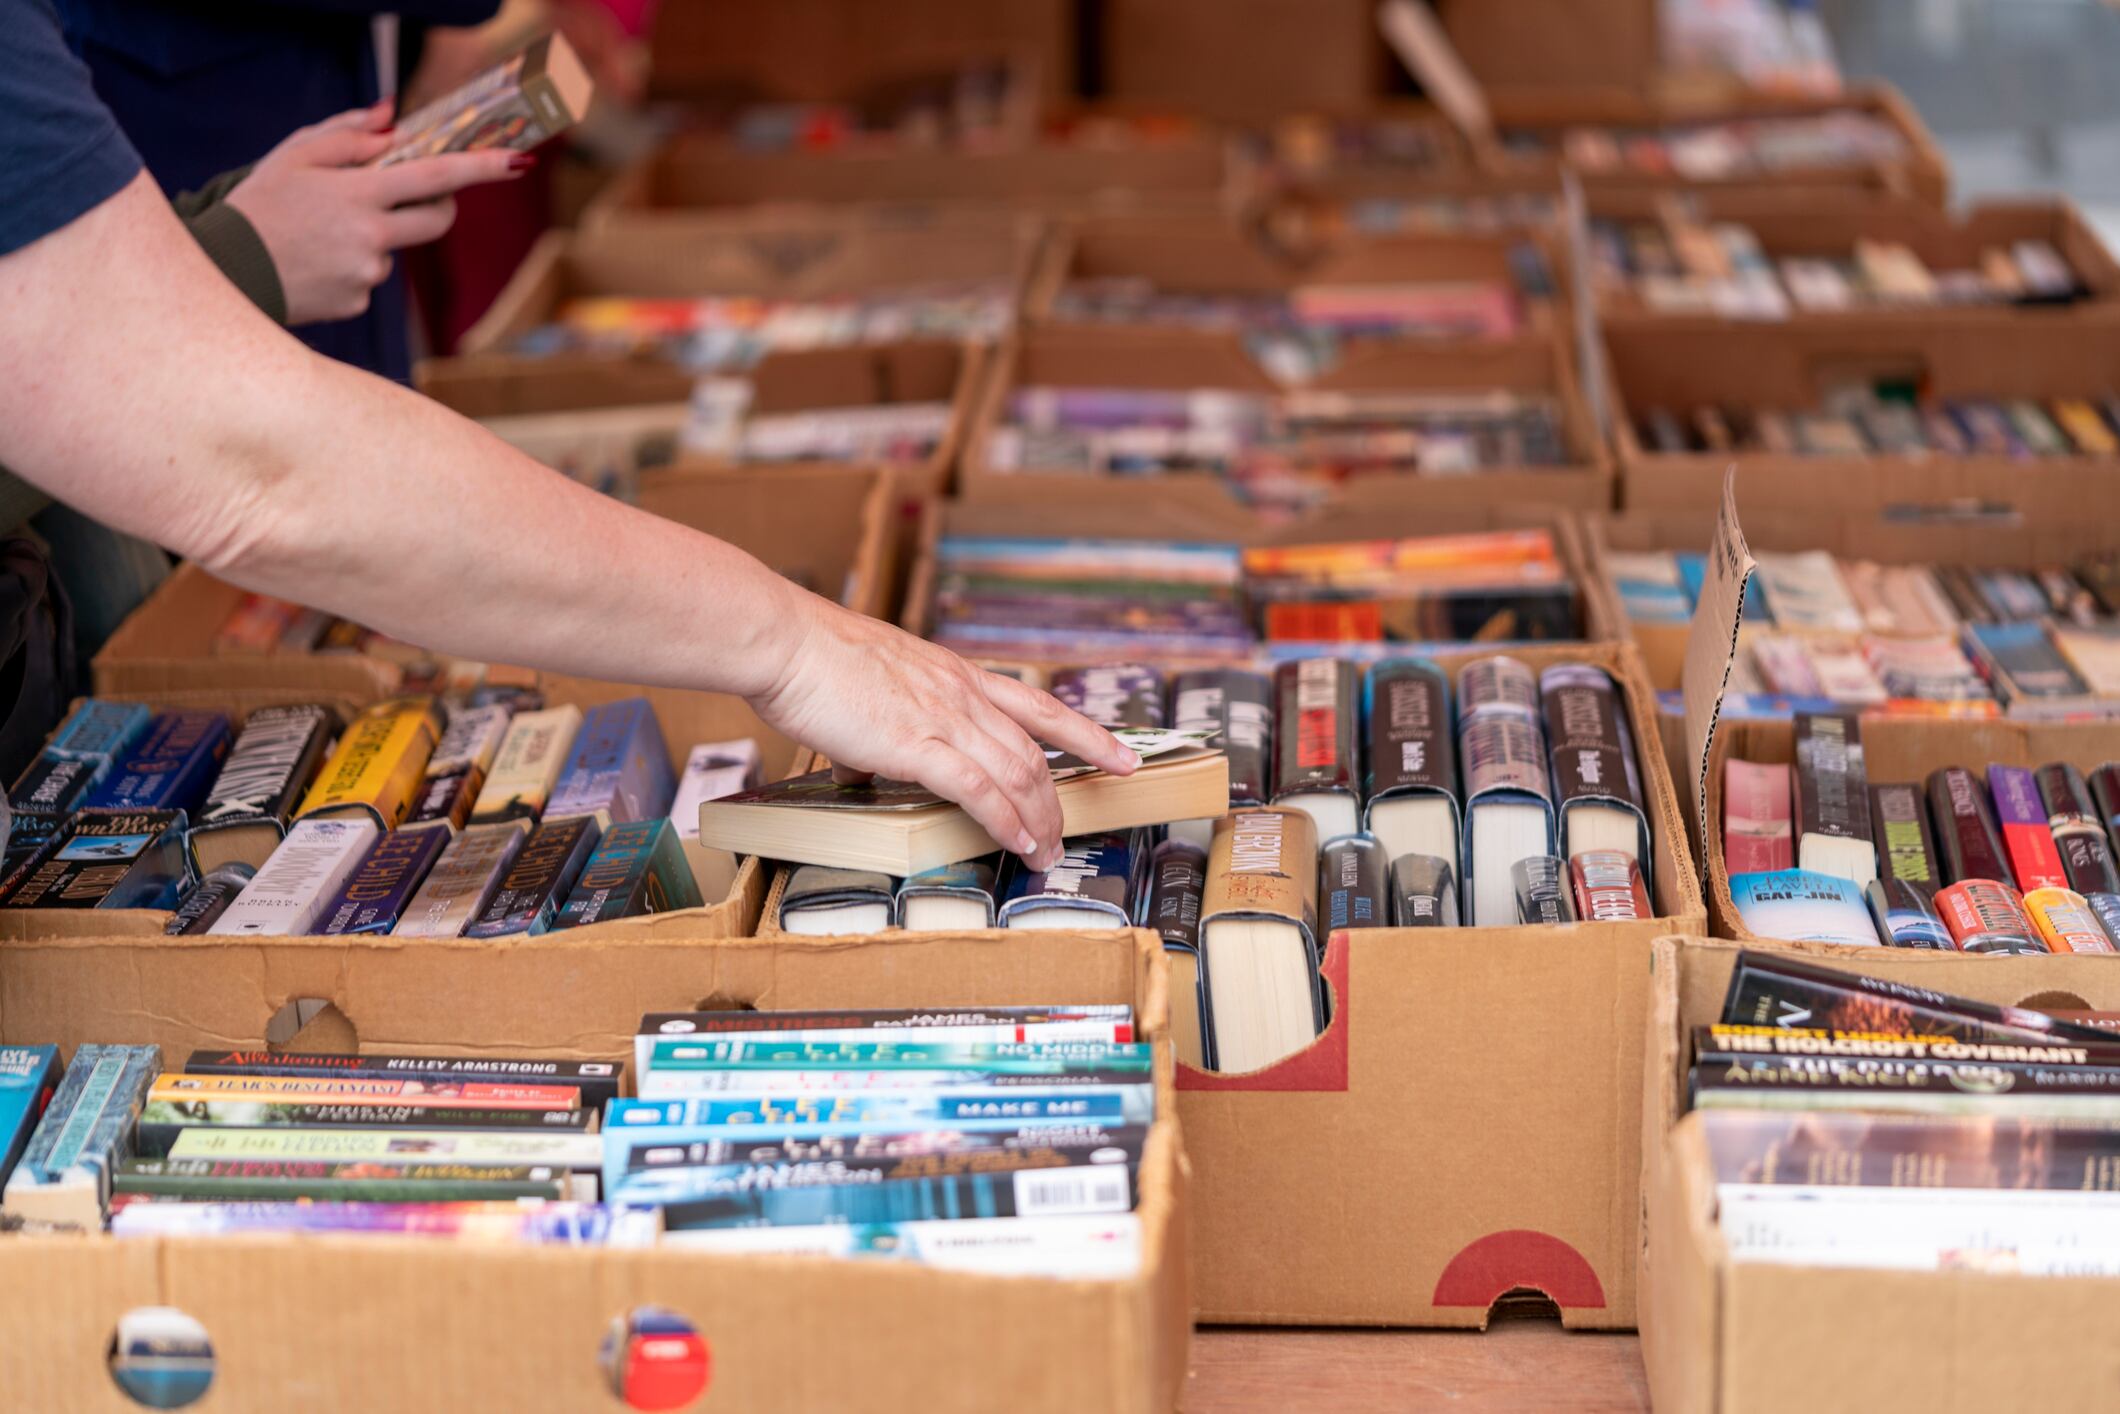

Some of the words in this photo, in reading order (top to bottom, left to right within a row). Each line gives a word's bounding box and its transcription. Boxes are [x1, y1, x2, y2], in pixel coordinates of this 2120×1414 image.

[74, 821, 170, 834] WILLIAMS
[1230, 813, 1283, 835] DAN
[1228, 835, 1283, 872] BROWN
[503, 847, 568, 889] CHILD
[581, 848, 640, 889] CHILD
[1160, 861, 1192, 889] LEON
[346, 856, 411, 900] CHILD
[1755, 892, 1842, 902] GAI-JIN
[996, 1044, 1037, 1056] NO
[1041, 1043, 1138, 1056] MIDDLE
[1715, 1034, 1772, 1053] THE
[1775, 1036, 1925, 1059] HOLCROFT
[1926, 1041, 2088, 1065] COVENANT
[387, 1058, 449, 1071] KELLEY
[452, 1061, 557, 1074] ARMSTRONG
[305, 1104, 426, 1116] CHRISTINE
[316, 1112, 408, 1122] FEEHAN
[956, 1102, 1038, 1117] MAKE
[1047, 1100, 1088, 1115] ME
